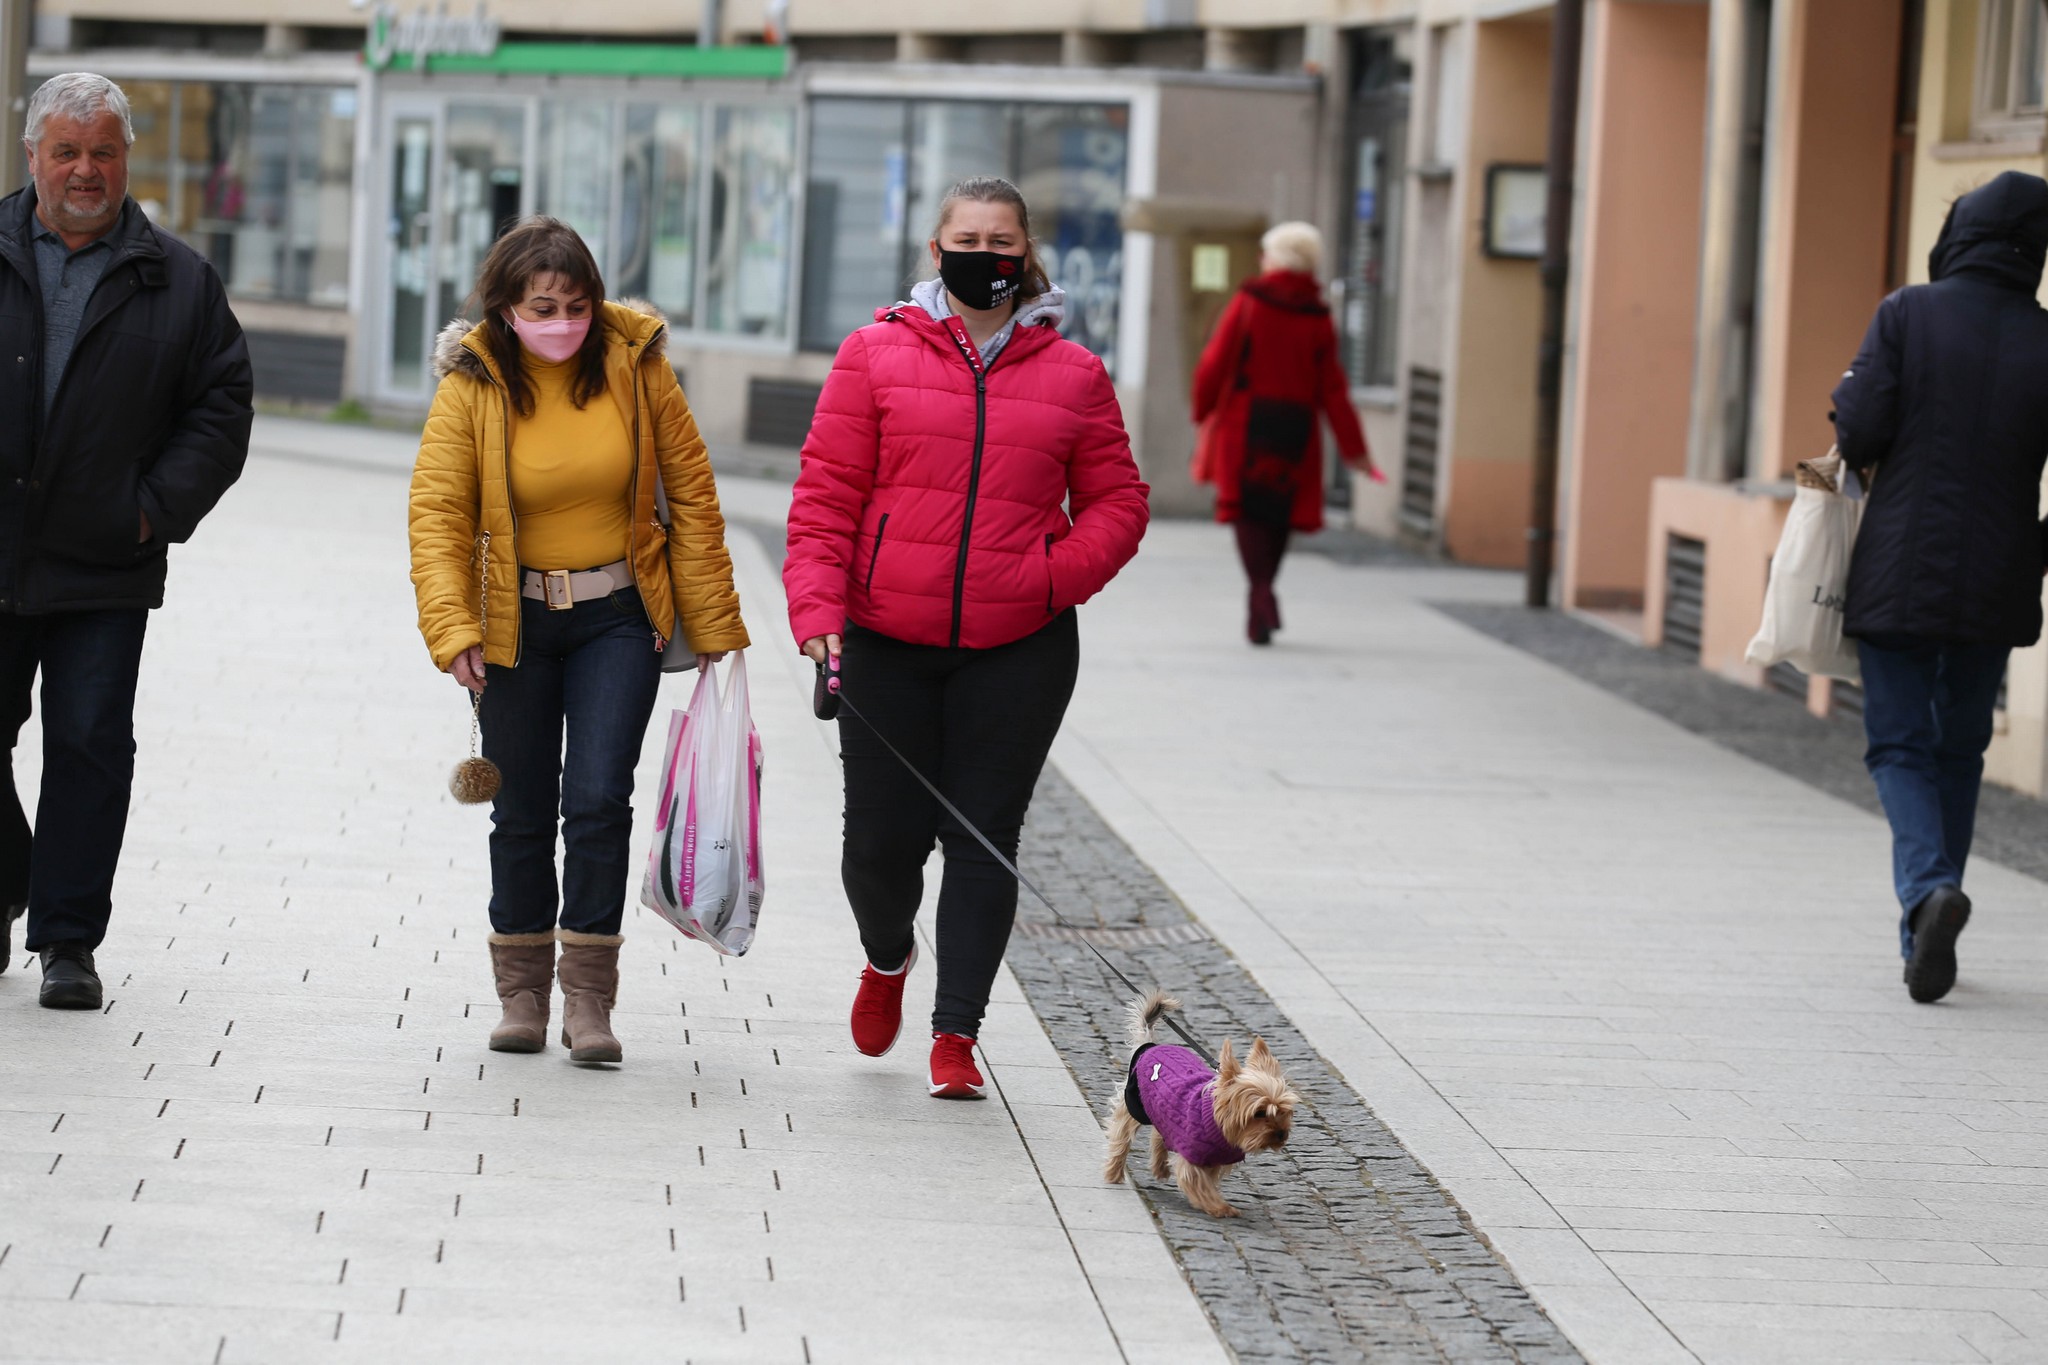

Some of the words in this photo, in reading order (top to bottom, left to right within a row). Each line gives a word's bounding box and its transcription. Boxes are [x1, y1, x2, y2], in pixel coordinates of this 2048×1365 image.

[991, 279, 1007, 290] MRS
[684, 856, 693, 883] LJEPŠI
[683, 885, 690, 896] ZA
